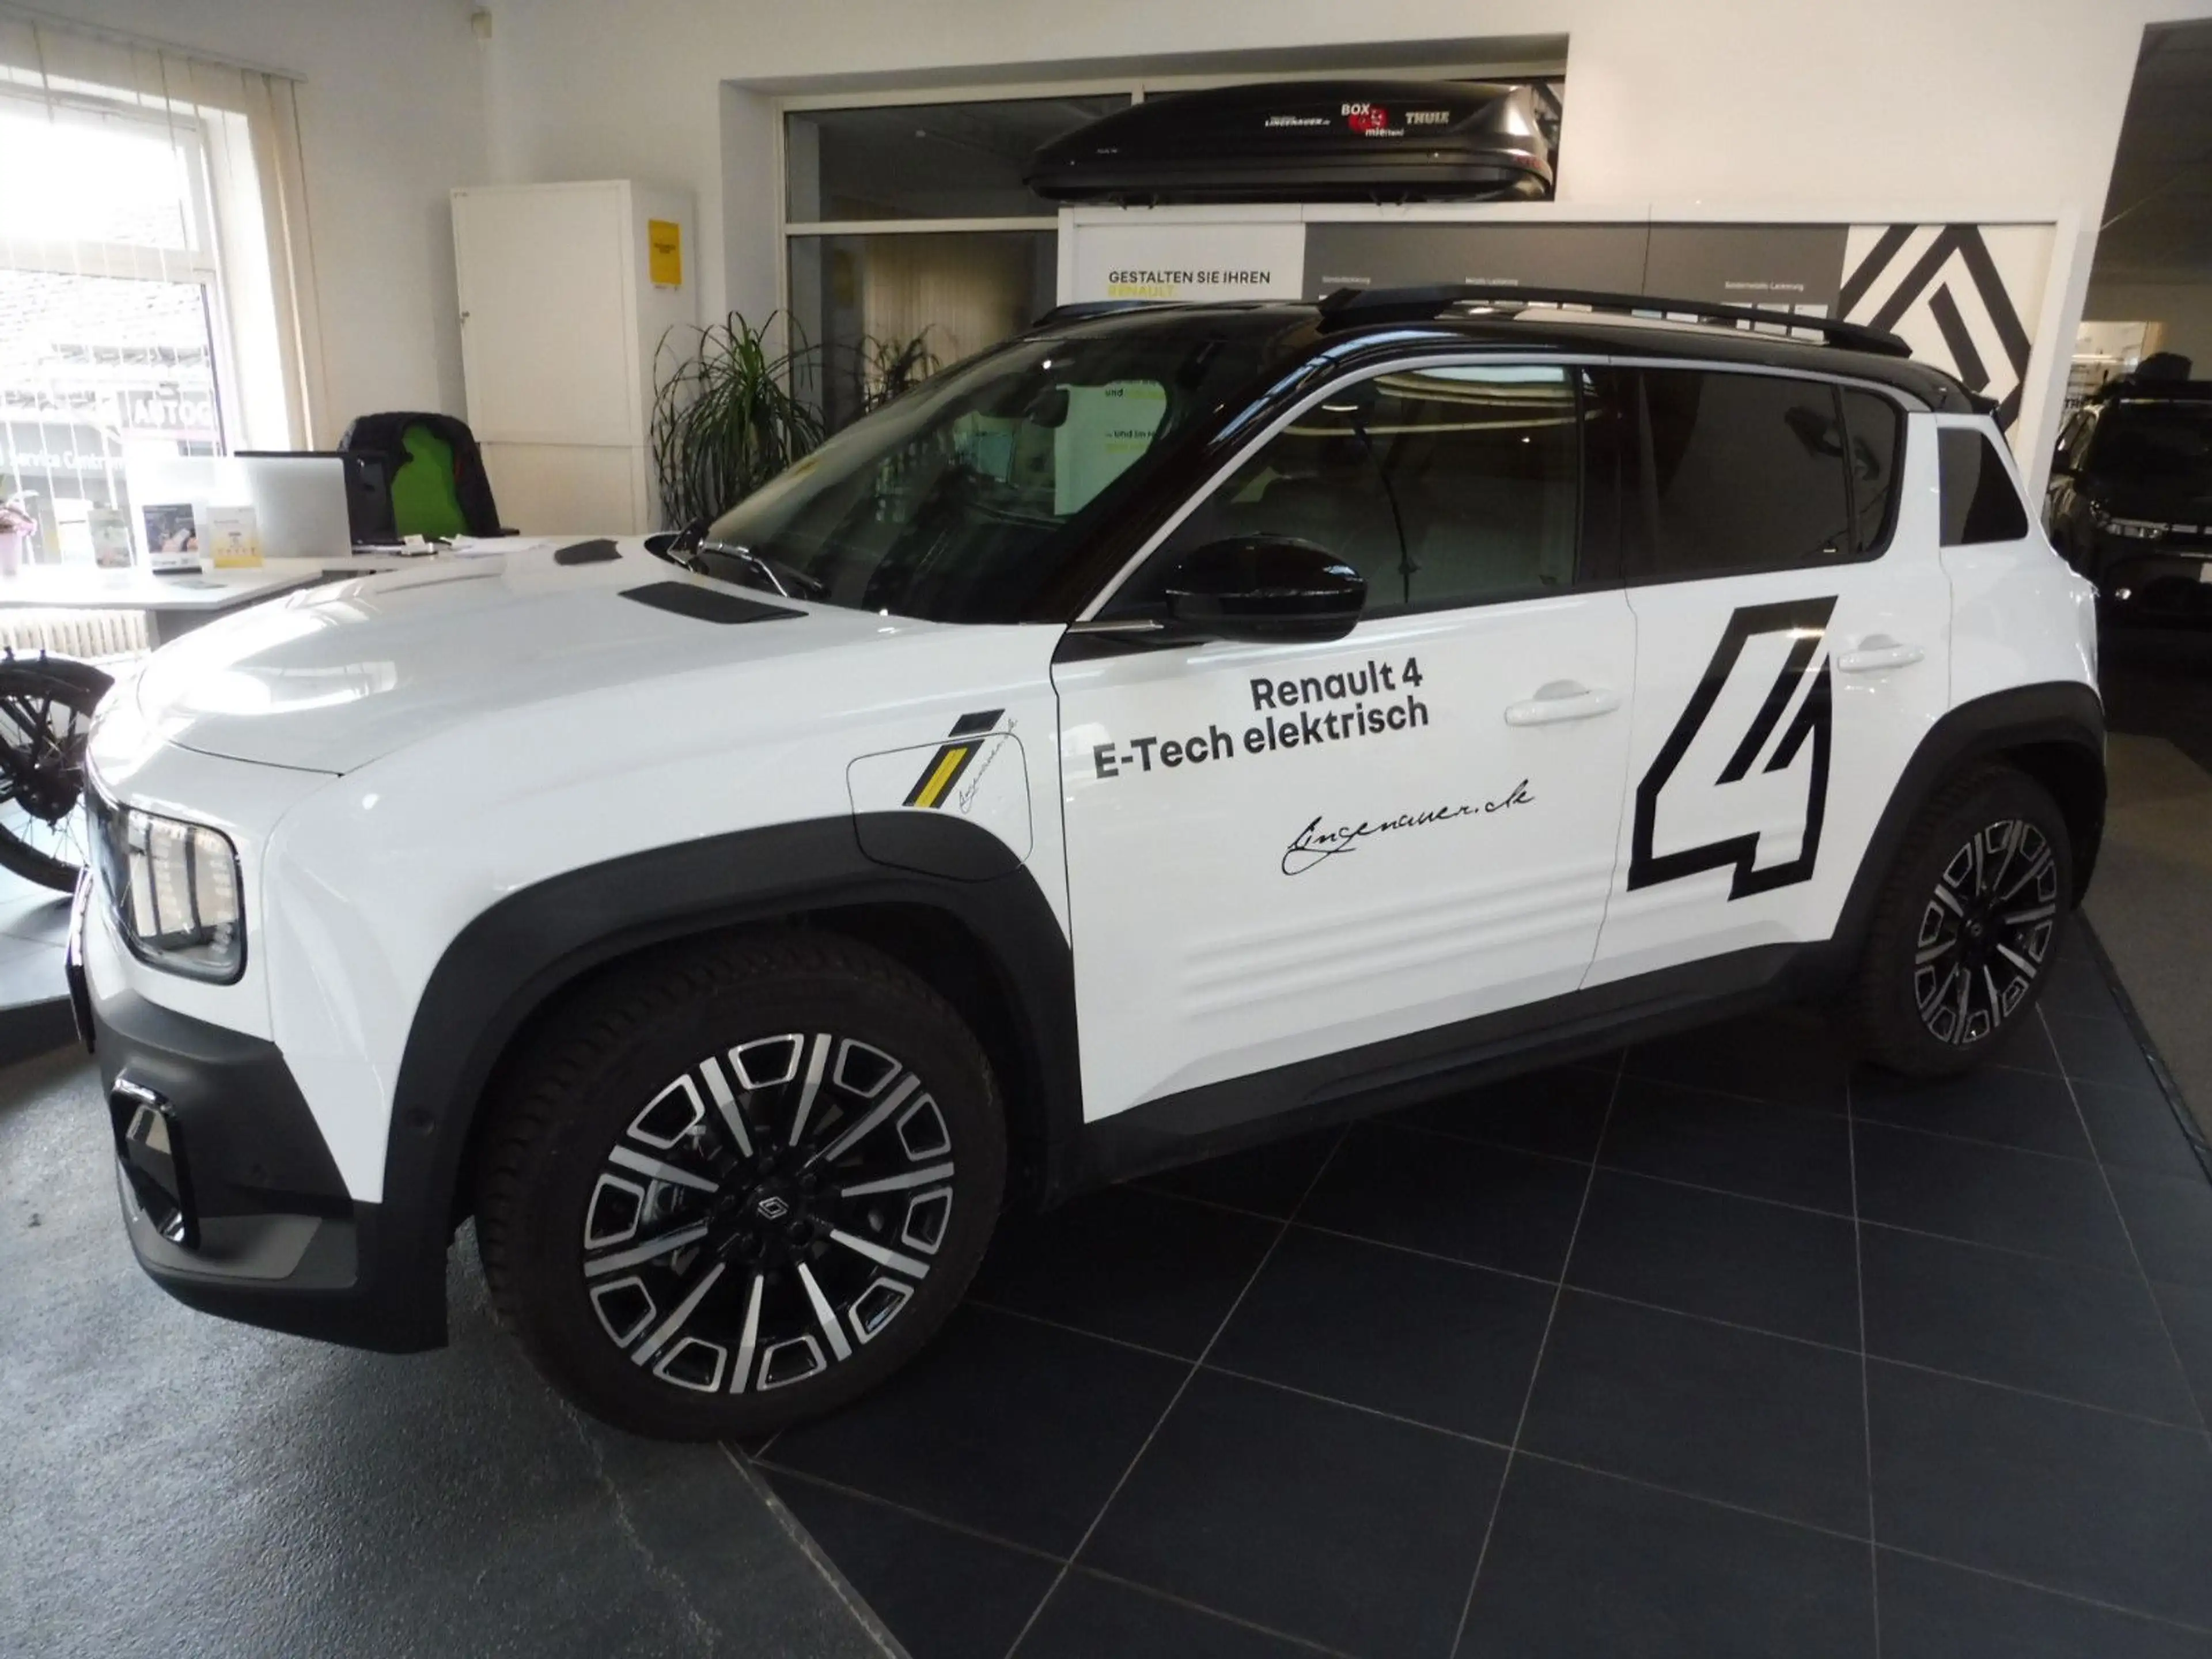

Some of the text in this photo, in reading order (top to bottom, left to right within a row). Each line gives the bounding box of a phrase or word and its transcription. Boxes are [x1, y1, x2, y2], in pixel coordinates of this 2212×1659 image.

[1341, 103, 1370, 116] BOX
[1405, 111, 1450, 125] THULE
[1108, 270, 1271, 284] GESTALTEN SIE IHREN
[1105, 388, 1123, 397] und
[1250, 657, 1424, 711] Renault 4
[1093, 695, 1429, 779] E-Tech elektrisch
